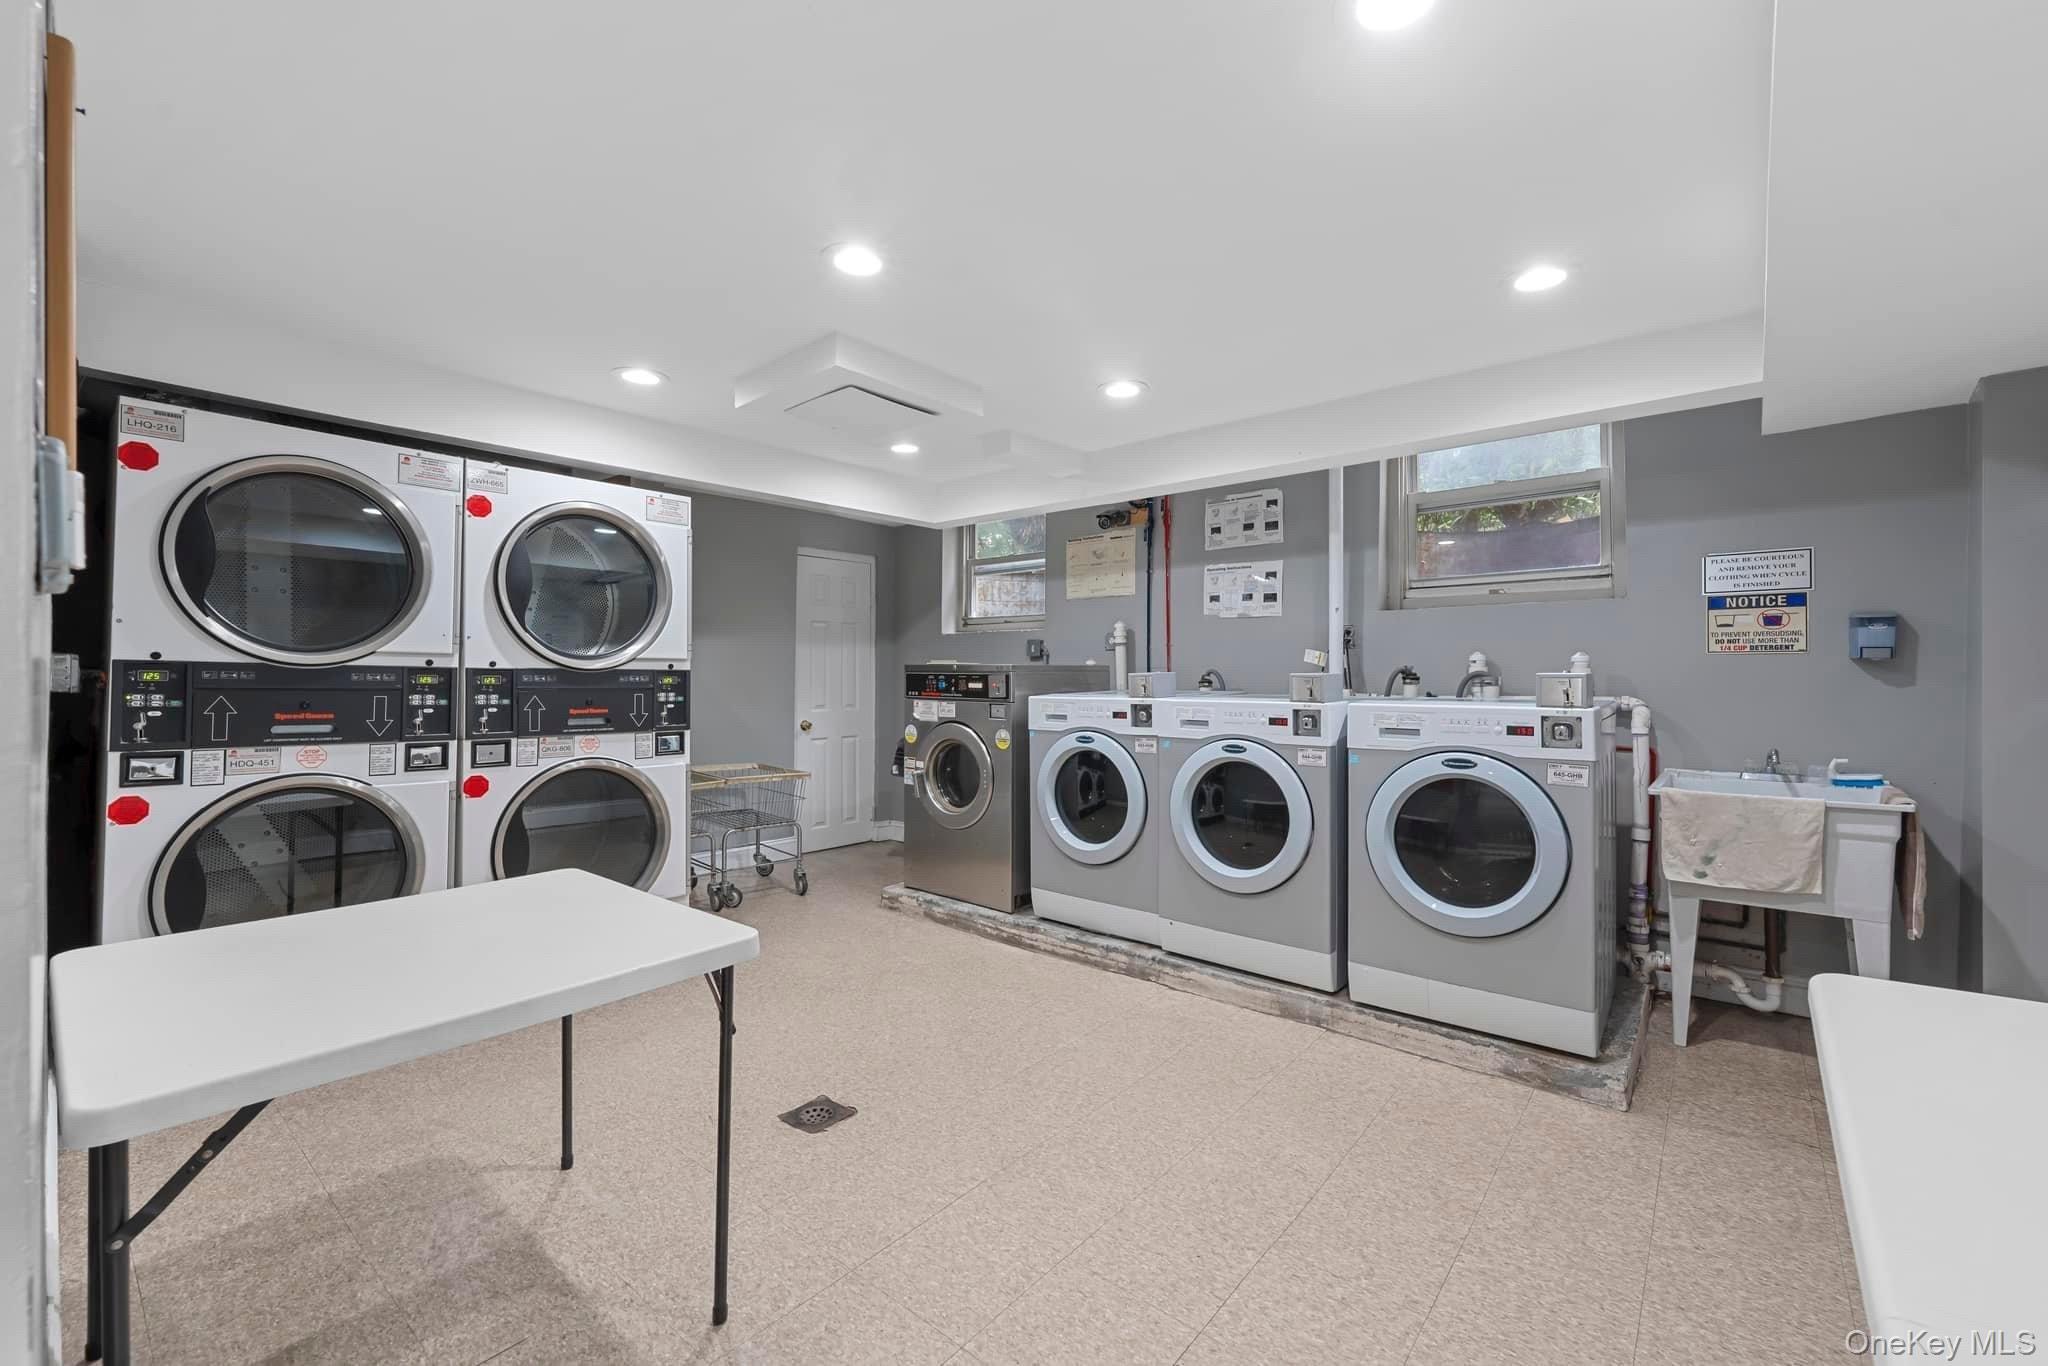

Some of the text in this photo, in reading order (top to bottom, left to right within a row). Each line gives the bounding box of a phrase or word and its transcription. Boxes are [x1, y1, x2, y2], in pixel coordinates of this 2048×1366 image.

[128, 418, 176, 432] LHQ-216
[1754, 554, 1805, 562] COURTEOUS
[1726, 595, 1787, 608] NOTICE
[230, 759, 275, 768] HDQ-451
